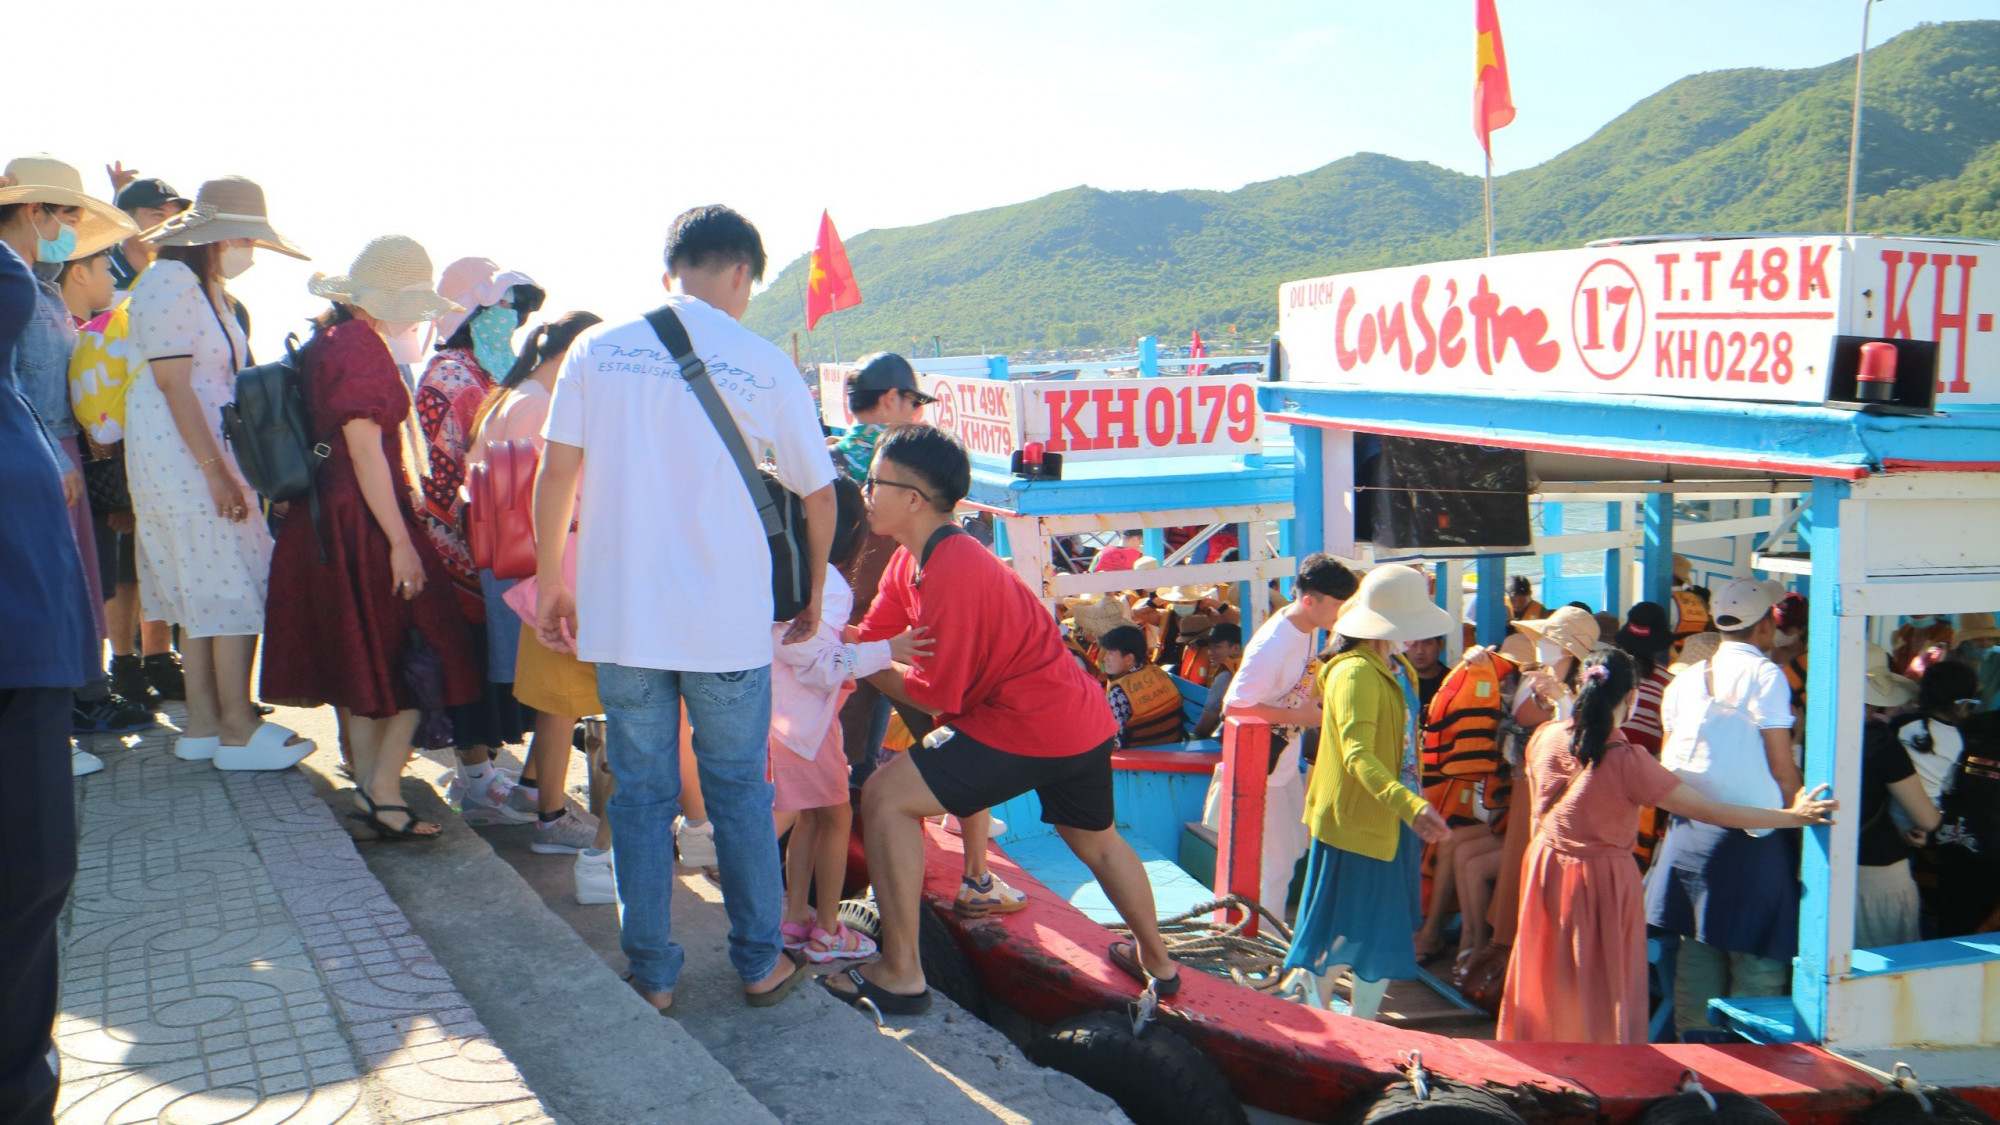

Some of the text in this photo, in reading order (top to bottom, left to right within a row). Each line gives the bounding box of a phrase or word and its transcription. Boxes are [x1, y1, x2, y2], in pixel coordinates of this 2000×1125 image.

[1290, 286, 1305, 308] DU
[1582, 285, 1635, 352] 17
[598, 361, 755, 402] ESTABLISHE 2015
[937, 392, 954, 429] 25
[957, 383, 976, 413] TT
[980, 386, 1008, 418] 49K
